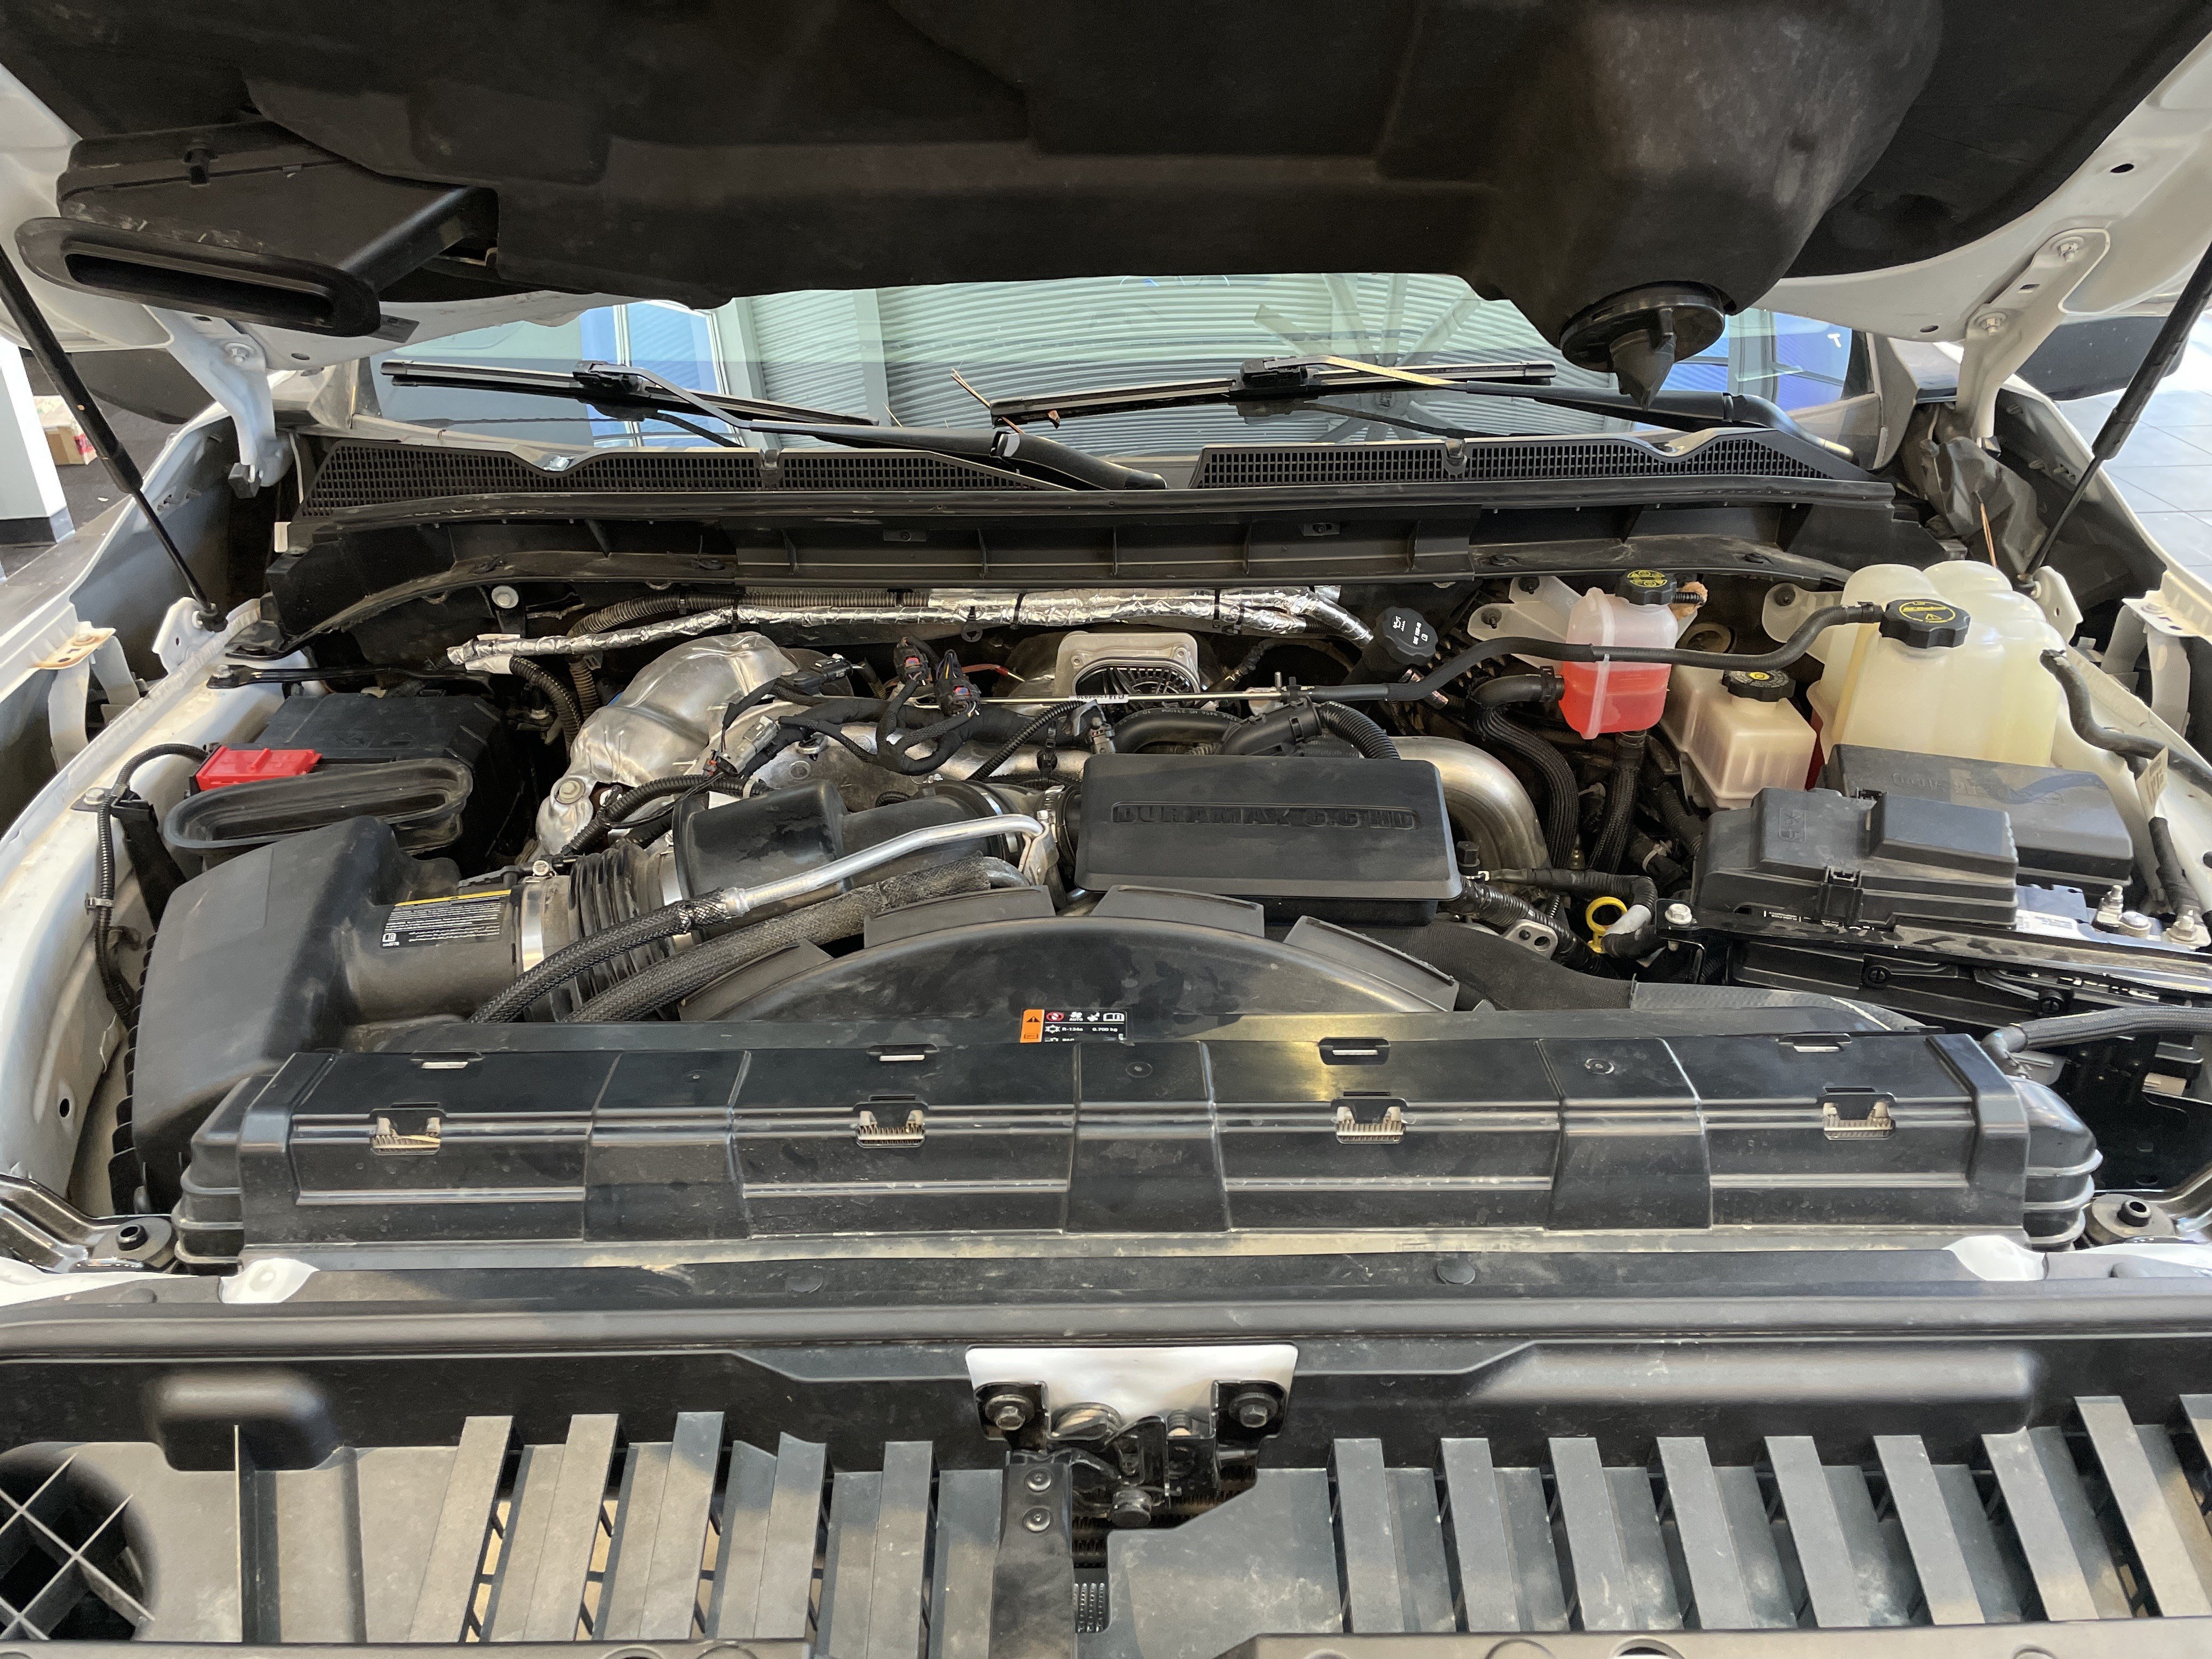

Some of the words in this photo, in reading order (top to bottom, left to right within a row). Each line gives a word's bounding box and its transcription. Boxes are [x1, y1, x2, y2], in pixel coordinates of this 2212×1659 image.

[1113, 805, 1290, 825] DURAMAX
[1308, 808, 1359, 827] 6.6
[1369, 810, 1415, 830] HD
